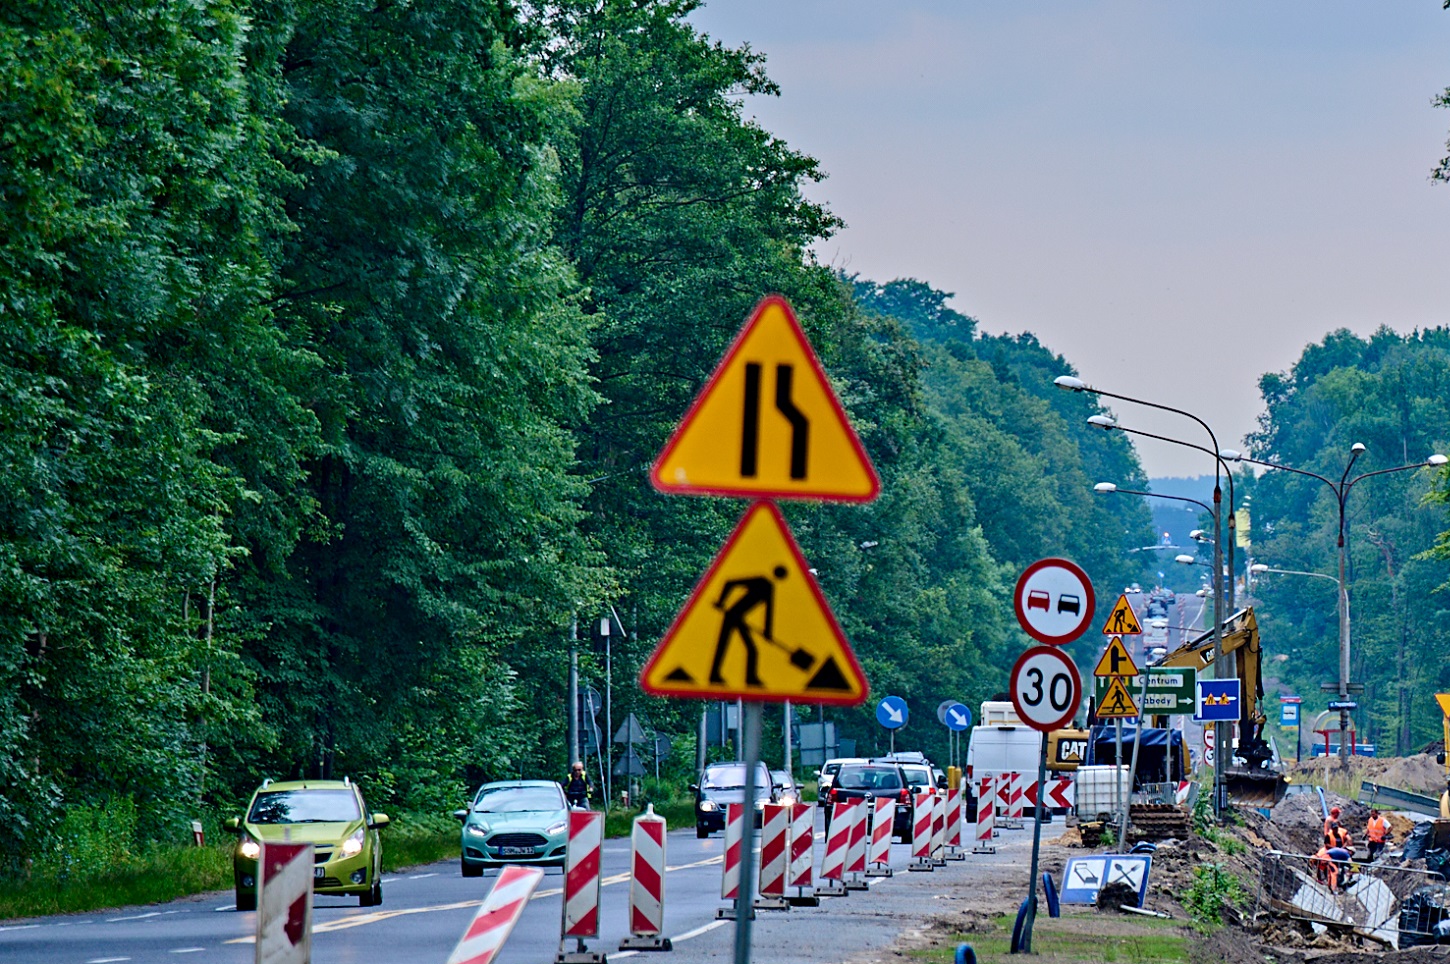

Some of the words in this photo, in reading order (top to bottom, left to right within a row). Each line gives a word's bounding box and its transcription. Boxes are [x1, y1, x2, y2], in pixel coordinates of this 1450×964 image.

[1022, 667, 1072, 712] 30
[1138, 676, 1178, 685] Cntrum
[1061, 741, 1088, 761] CAT
